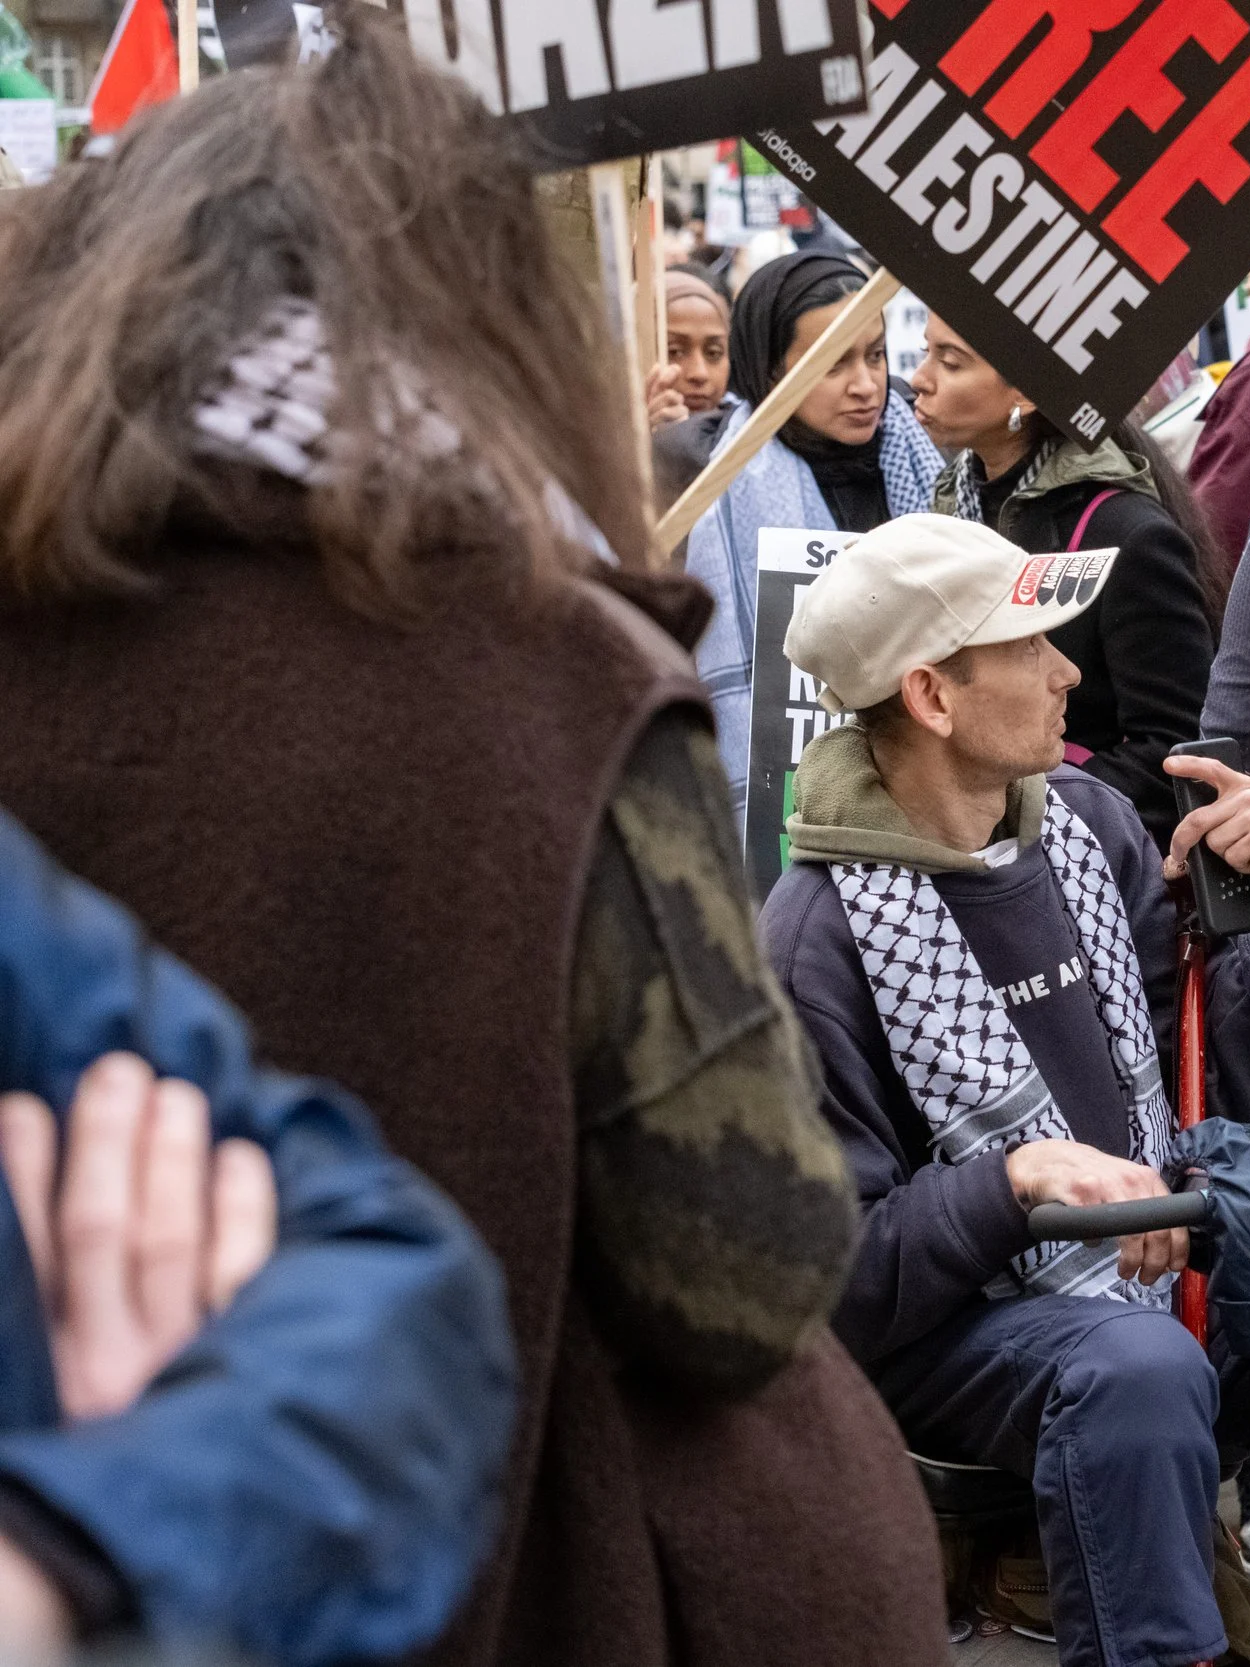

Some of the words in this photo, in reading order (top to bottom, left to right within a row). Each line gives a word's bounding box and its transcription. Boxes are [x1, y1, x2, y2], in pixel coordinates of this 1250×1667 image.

[811, 13, 1150, 374] ALESTINE
[1069, 401, 1106, 441] FOA
[1020, 557, 1051, 596] CAMPAIGN
[993, 973, 1051, 1010] THE
